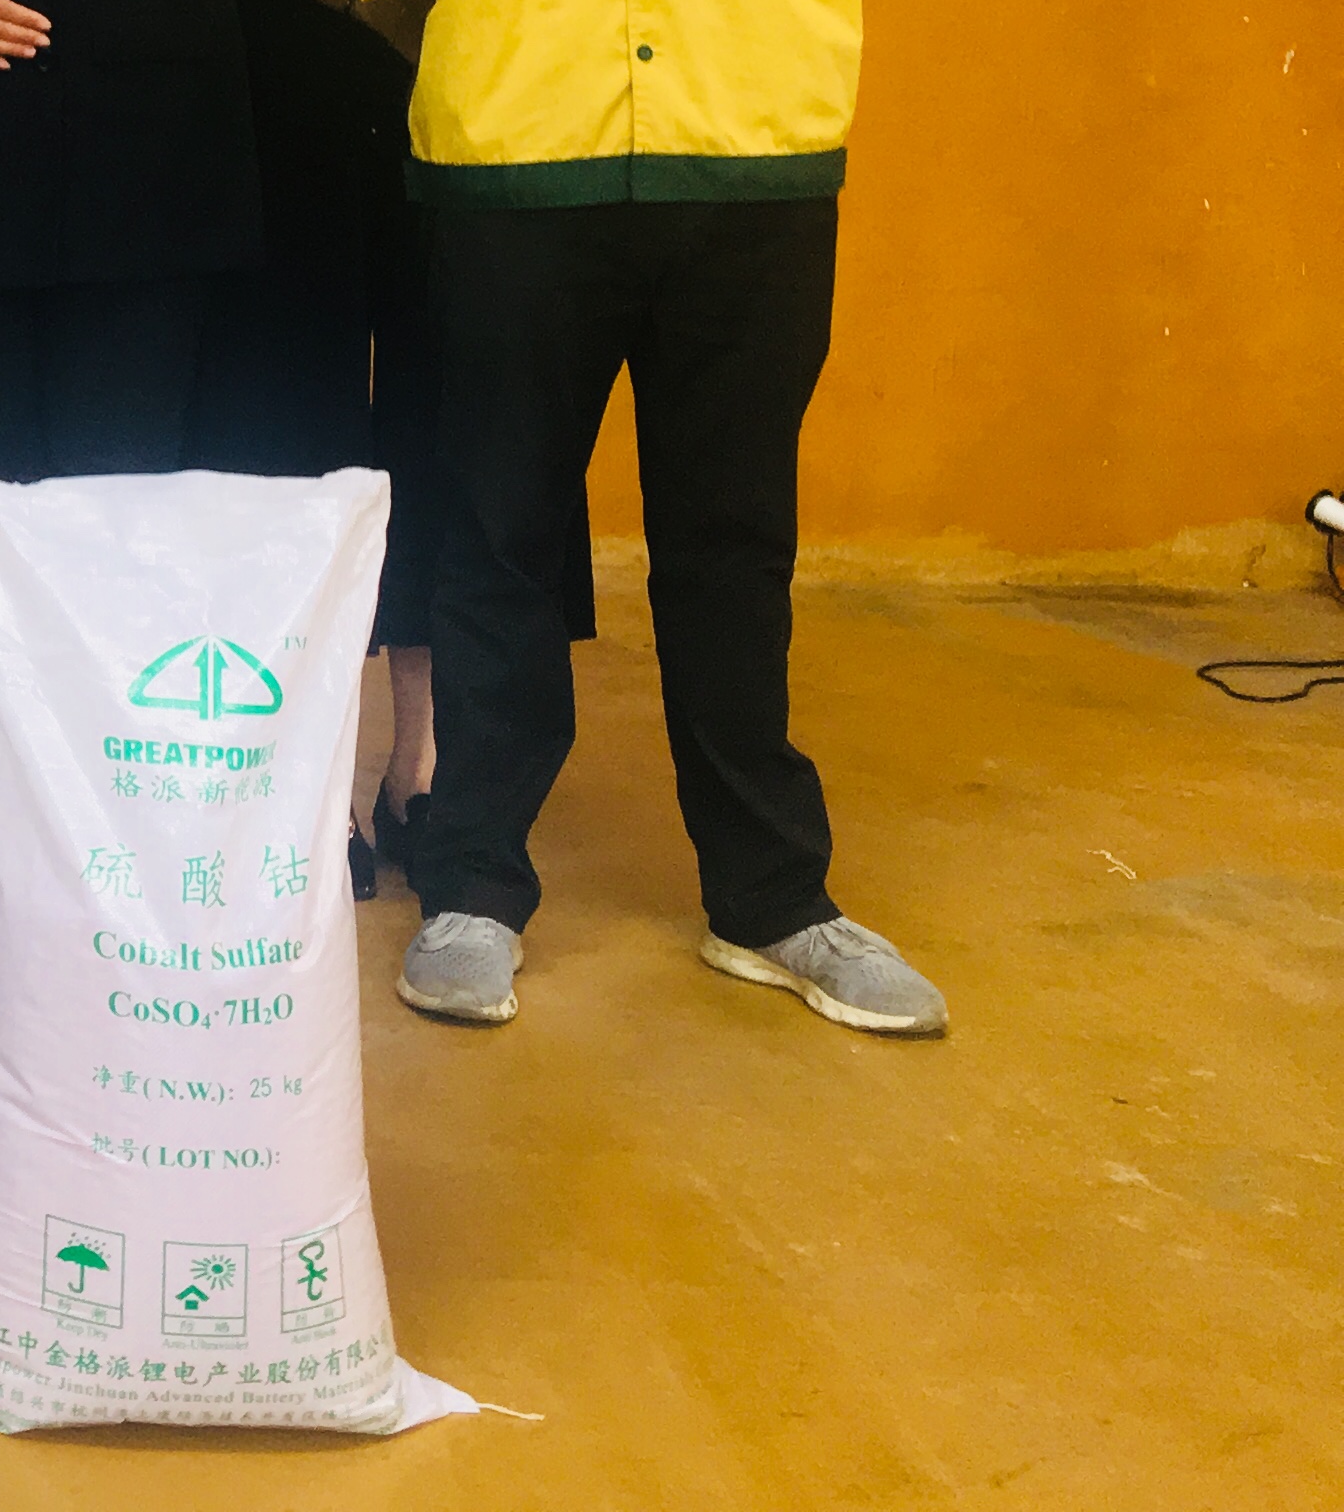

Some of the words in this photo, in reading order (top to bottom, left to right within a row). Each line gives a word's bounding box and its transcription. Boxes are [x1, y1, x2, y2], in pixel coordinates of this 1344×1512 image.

[103, 736, 277, 773] GREATPOW
[110, 768, 276, 807] 格派新能源
[79, 842, 310, 910] 硫酸钴
[93, 930, 203, 972] Cobalt
[211, 935, 304, 970] Sulfate
[249, 1076, 272, 1099] 25
[283, 1075, 304, 1096] kg
[58, 1376, 140, 1402] Jinchuan
